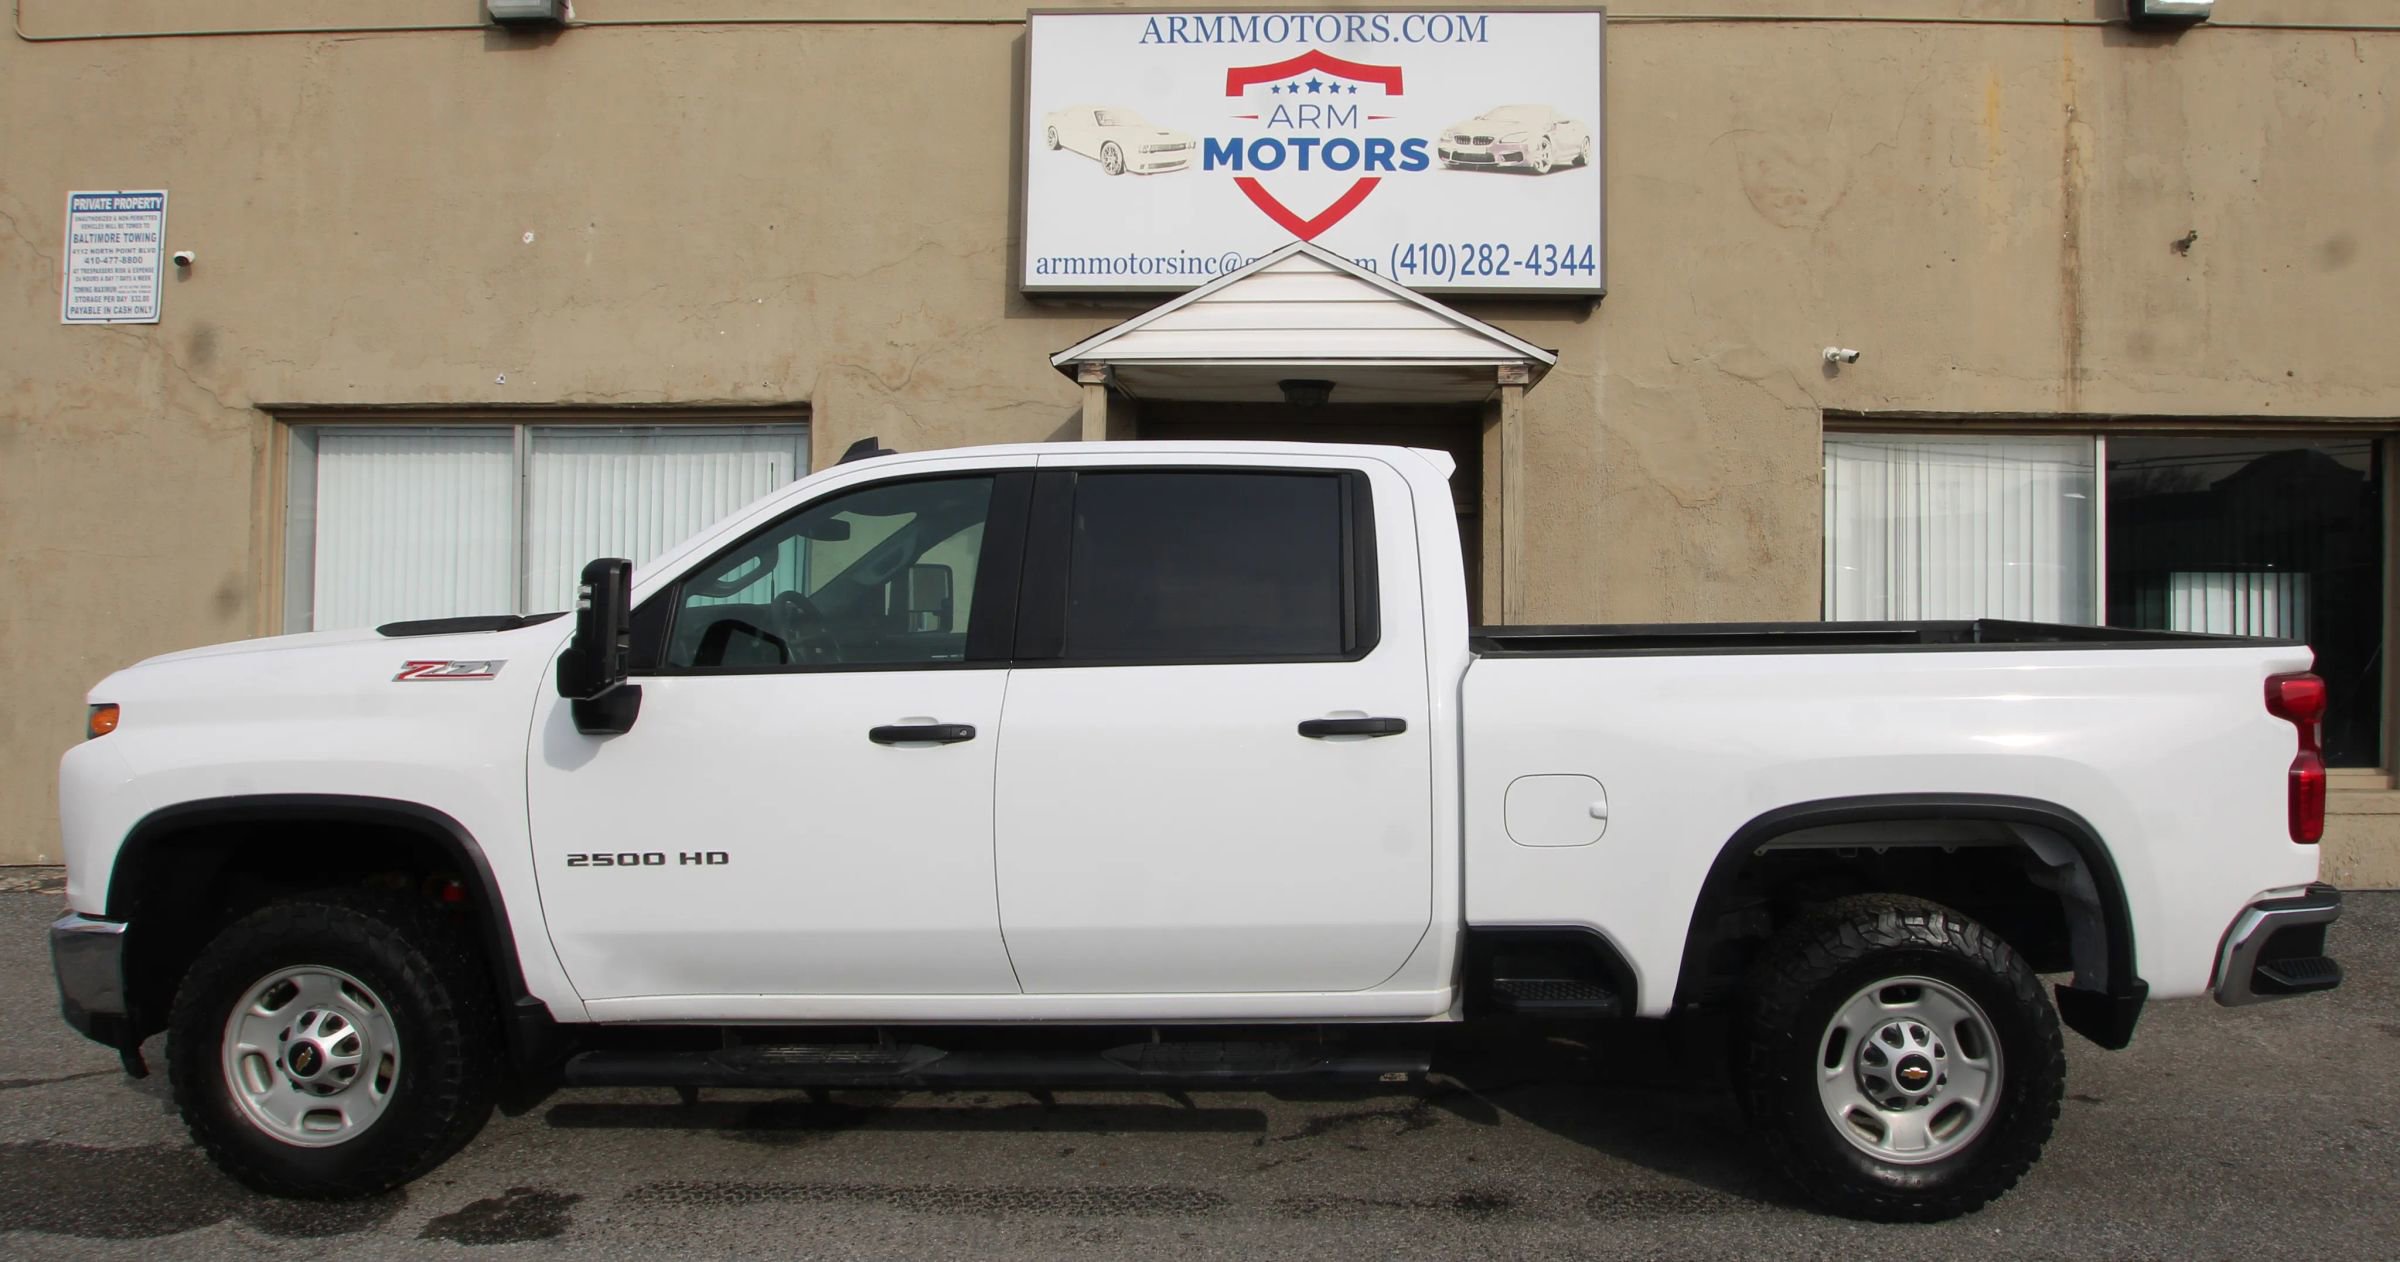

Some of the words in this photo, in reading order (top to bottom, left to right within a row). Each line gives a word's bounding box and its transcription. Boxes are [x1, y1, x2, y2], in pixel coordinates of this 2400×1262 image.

[1139, 14, 1489, 45] ARMMOTORS.COM
[1267, 103, 1358, 130] ARM
[1203, 136, 1430, 172] MOTORS
[73, 198, 112, 210] PRIVATE
[113, 197, 163, 209] PROPERTY
[73, 233, 121, 243] BALTIMORE
[123, 232, 157, 243] TOWING
[84, 256, 143, 264] 410-477-8800
[70, 306, 102, 315] PAYABLE
[103, 306, 111, 314] IN
[113, 306, 131, 314] CASH
[134, 305, 153, 314] ONLY
[567, 852, 666, 867] 2500
[680, 851, 729, 865] HD
